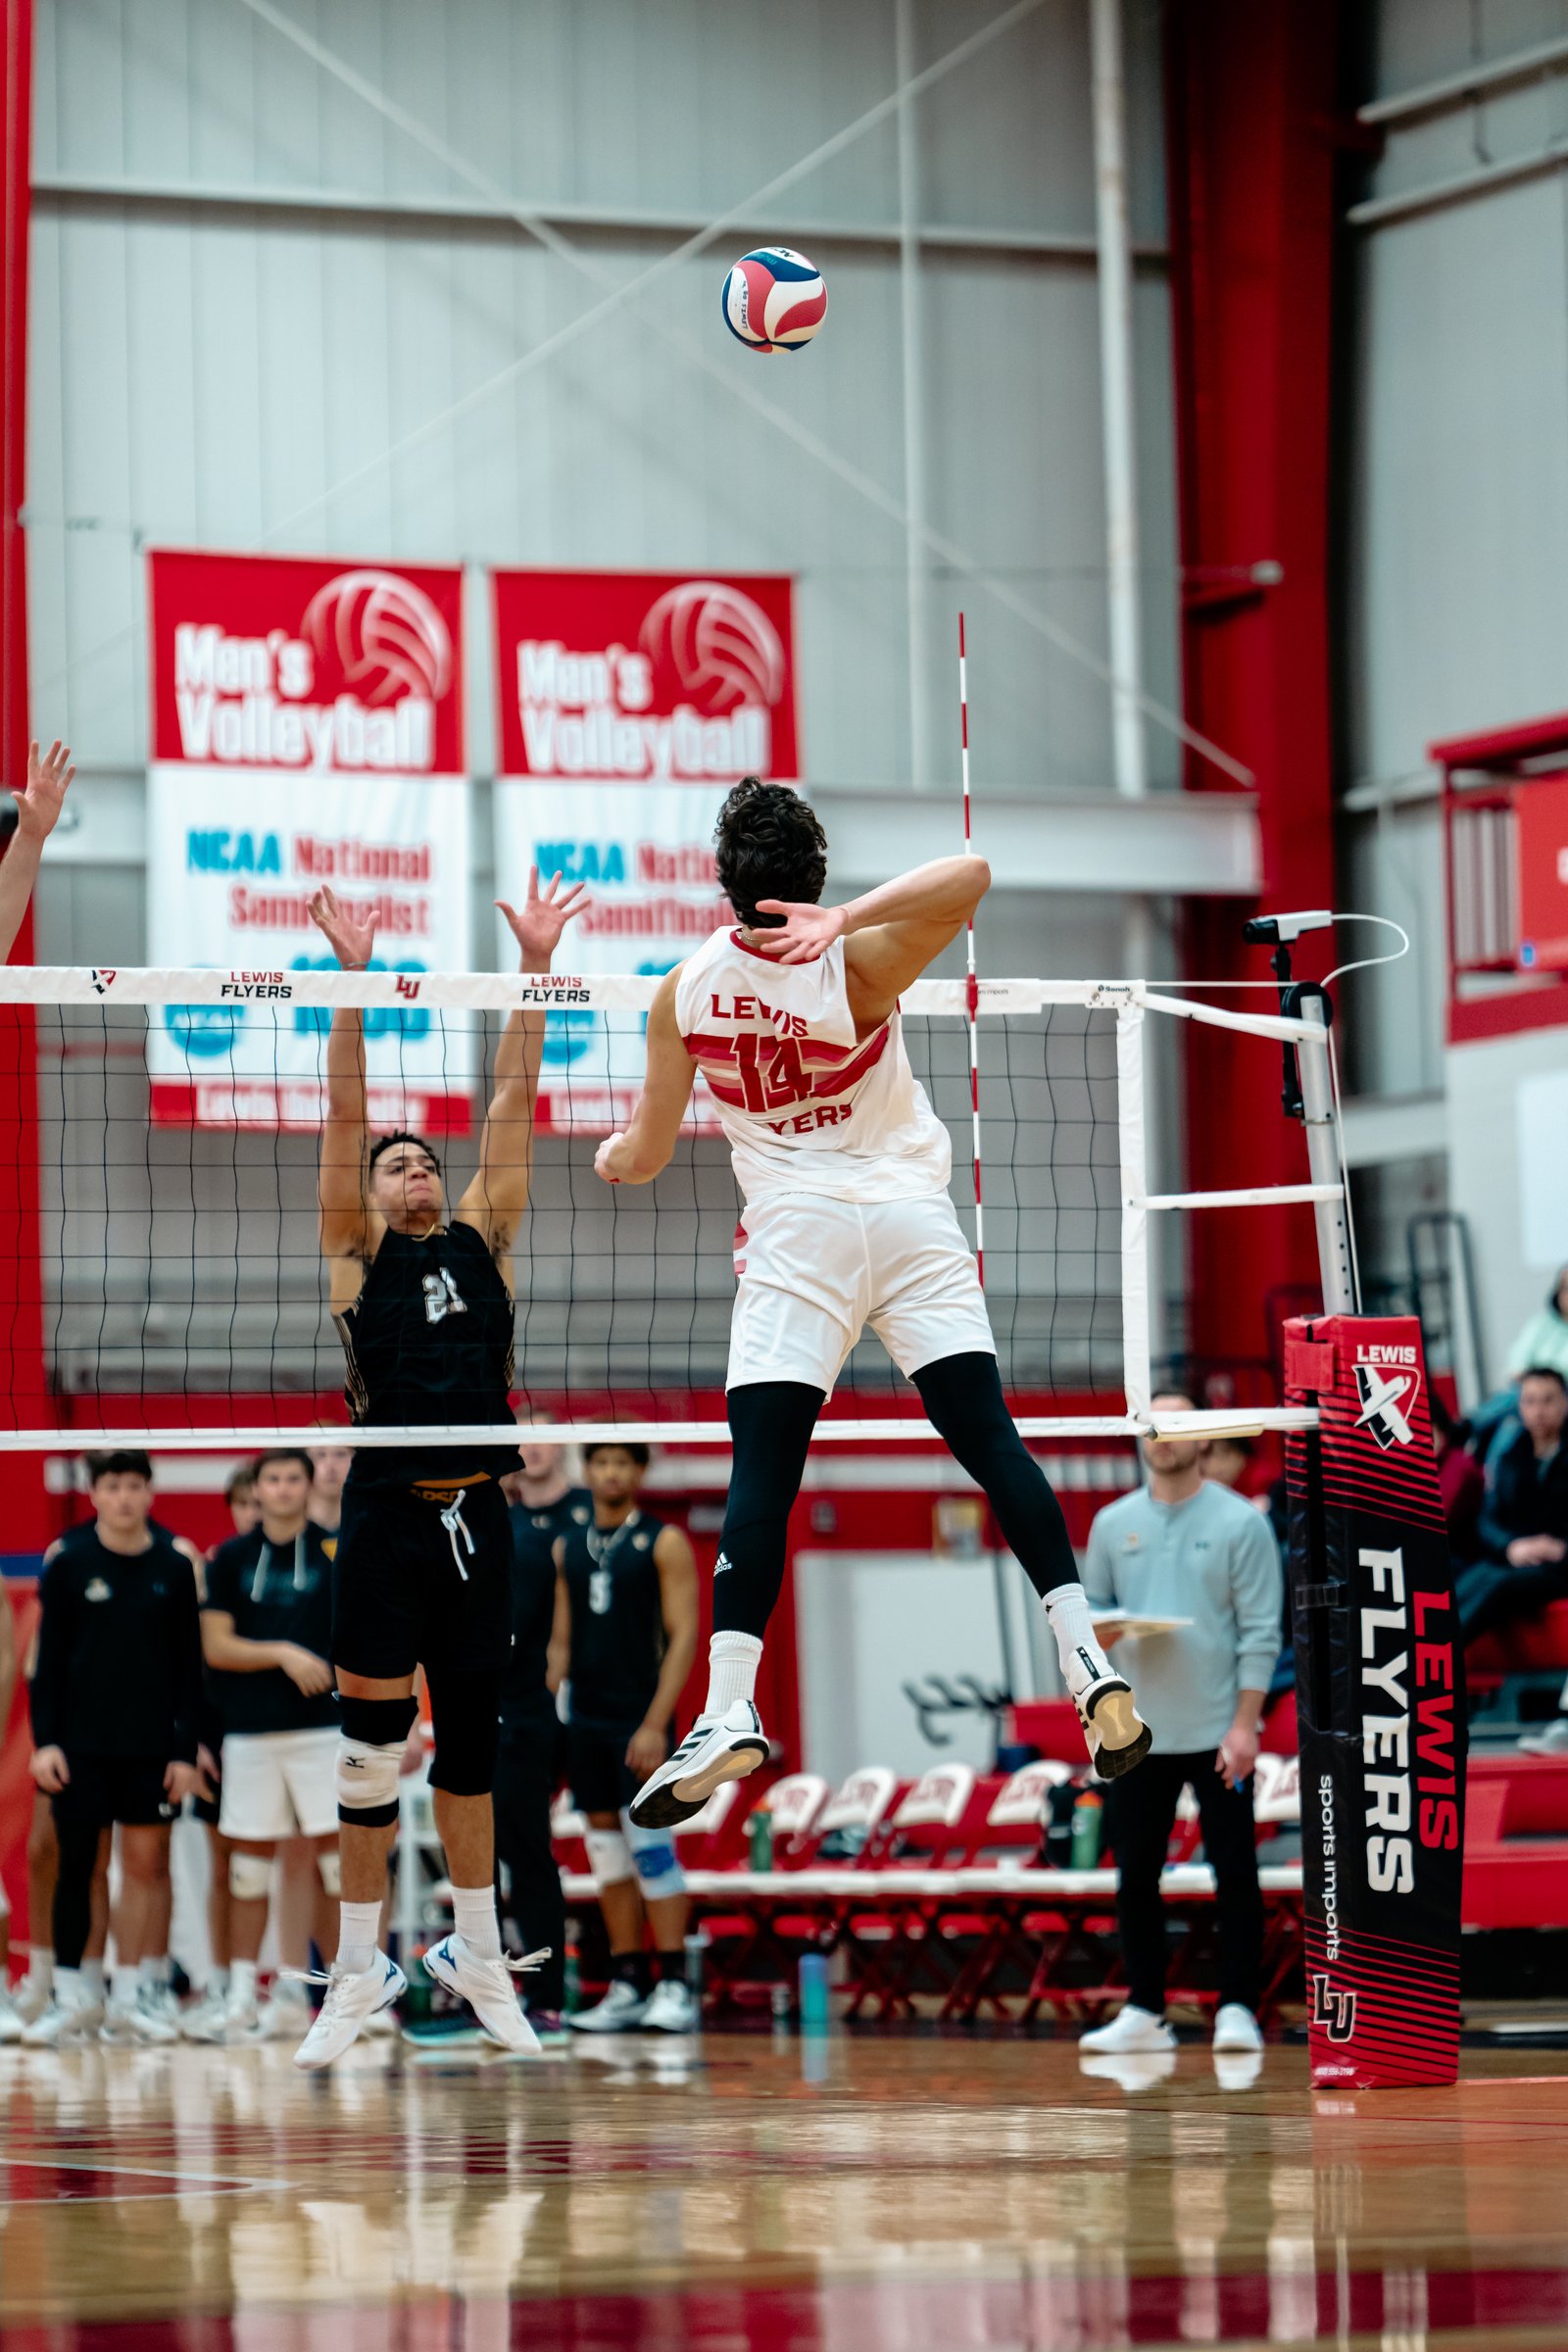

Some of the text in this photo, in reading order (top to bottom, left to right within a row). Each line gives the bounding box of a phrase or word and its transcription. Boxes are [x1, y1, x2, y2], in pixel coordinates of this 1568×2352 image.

[174, 621, 314, 701] Men's
[517, 640, 653, 711] Men's
[175, 691, 434, 772] Volleyball
[519, 703, 771, 783] Volleyball
[186, 830, 433, 884] NCAA National
[534, 842, 624, 883] NCAA
[221, 984, 292, 999] FLYERS
[230, 971, 283, 983] LEWIS
[395, 974, 420, 1000] LU
[521, 989, 591, 1002] FLYERS
[530, 976, 582, 987] LEWIS
[710, 994, 809, 1038] LEWIS
[730, 1032, 815, 1113] 14
[422, 1266, 468, 1324] 21
[1356, 1344, 1417, 1364] LEWIS
[1358, 1546, 1414, 1893] FLYERS
[1413, 1590, 1459, 1850] LEWIS
[1318, 1775, 1341, 1961] sports imports
[1312, 1974, 1357, 2043] LU
